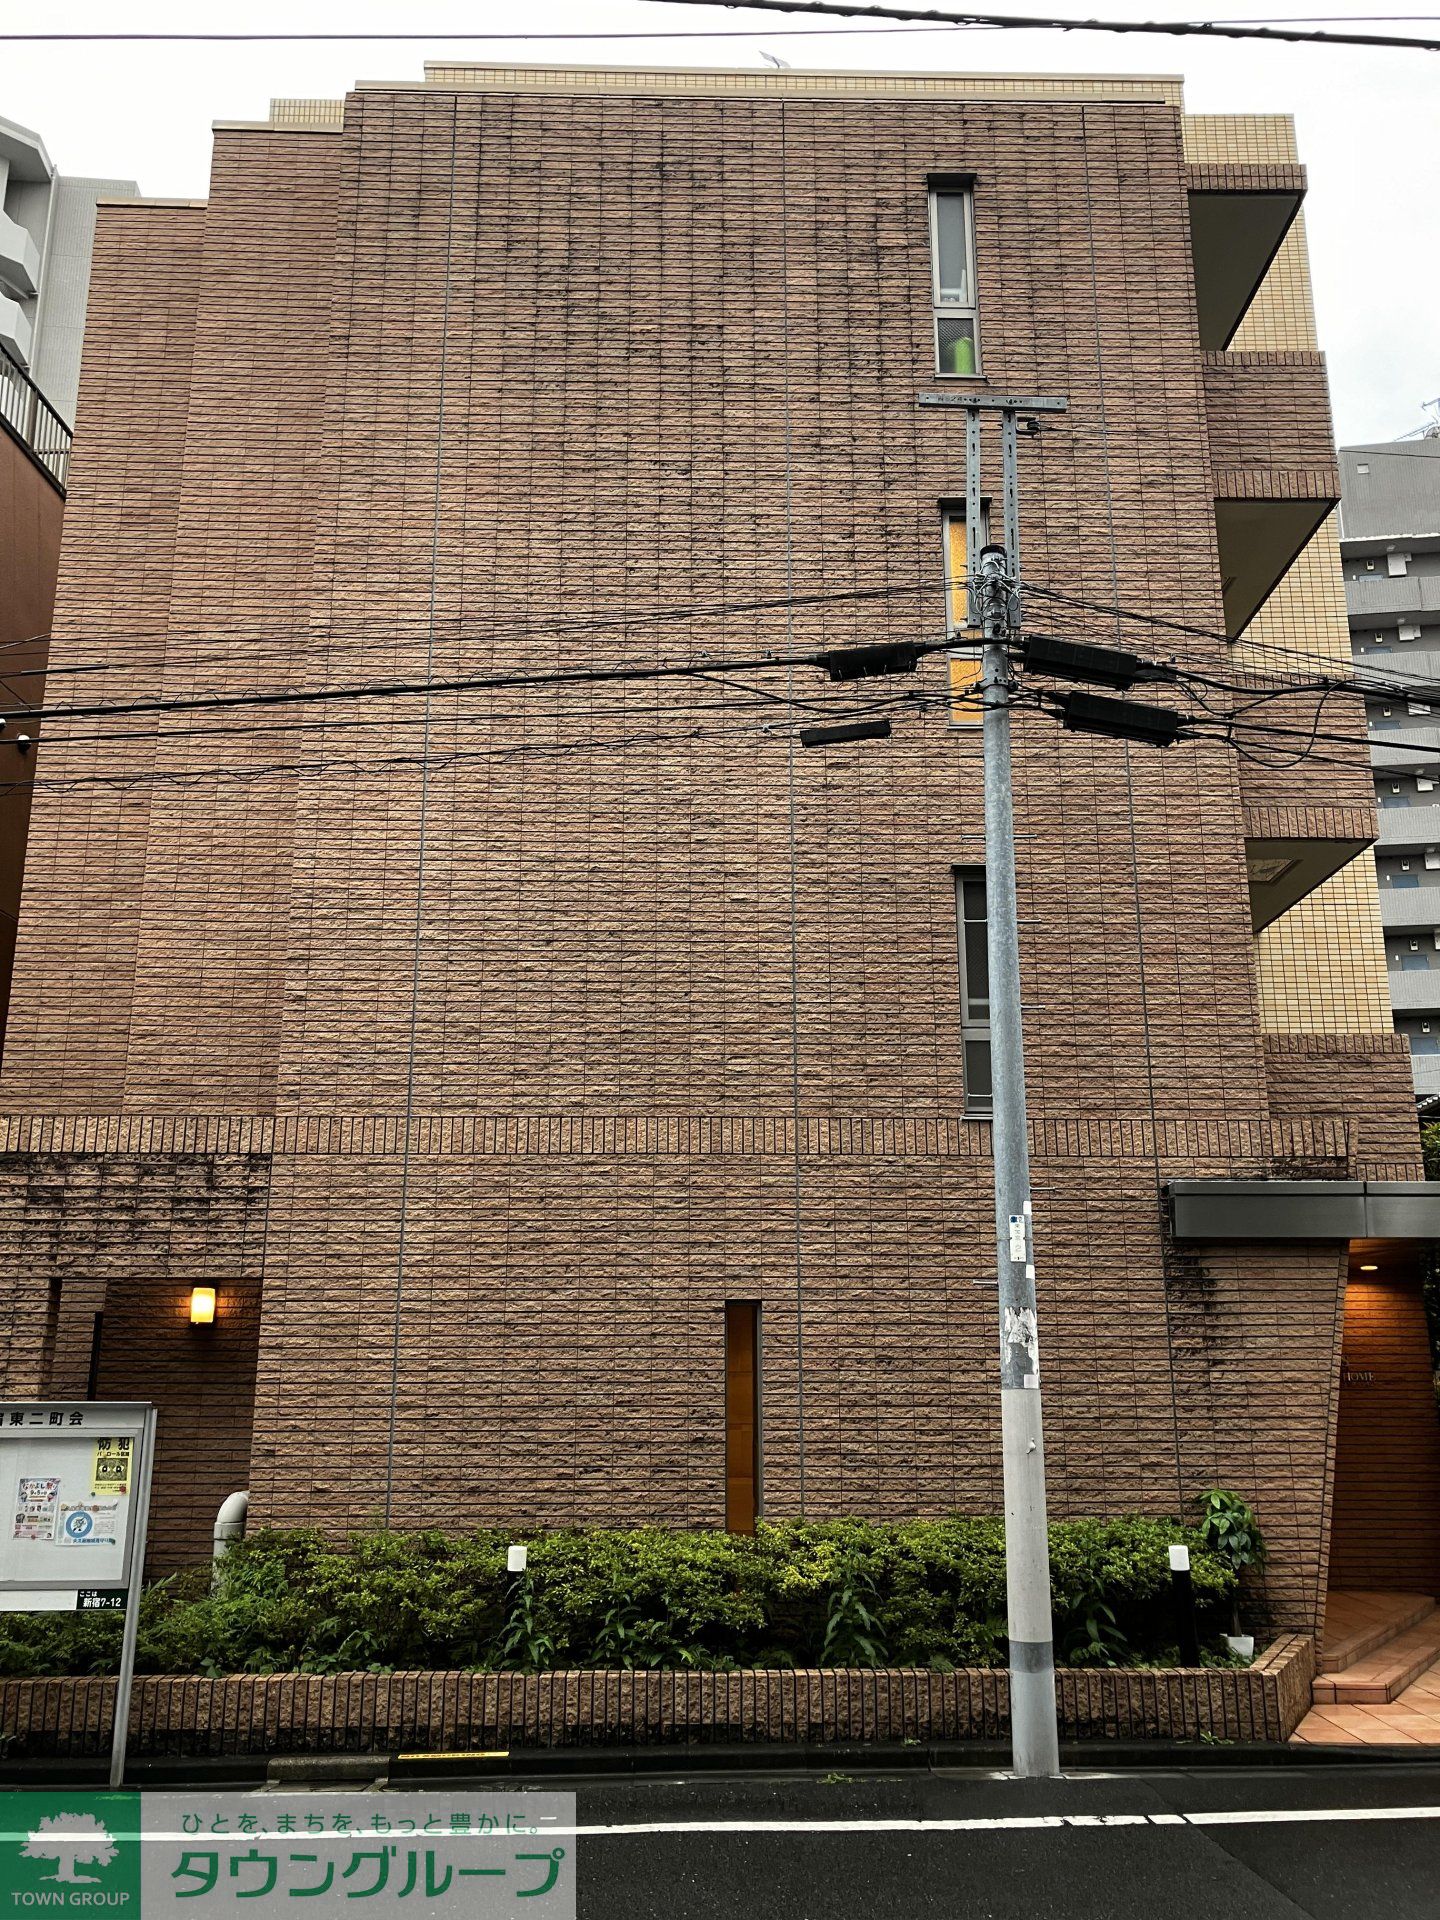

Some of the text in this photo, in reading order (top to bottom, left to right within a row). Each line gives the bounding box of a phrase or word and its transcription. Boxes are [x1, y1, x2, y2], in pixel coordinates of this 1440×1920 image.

[0, 1411, 84, 1427] 東二町会
[97, 1437, 130, 1451] 防犯
[79, 1590, 98, 1598] ここは
[82, 1597, 122, 1608] 新宿7-12
